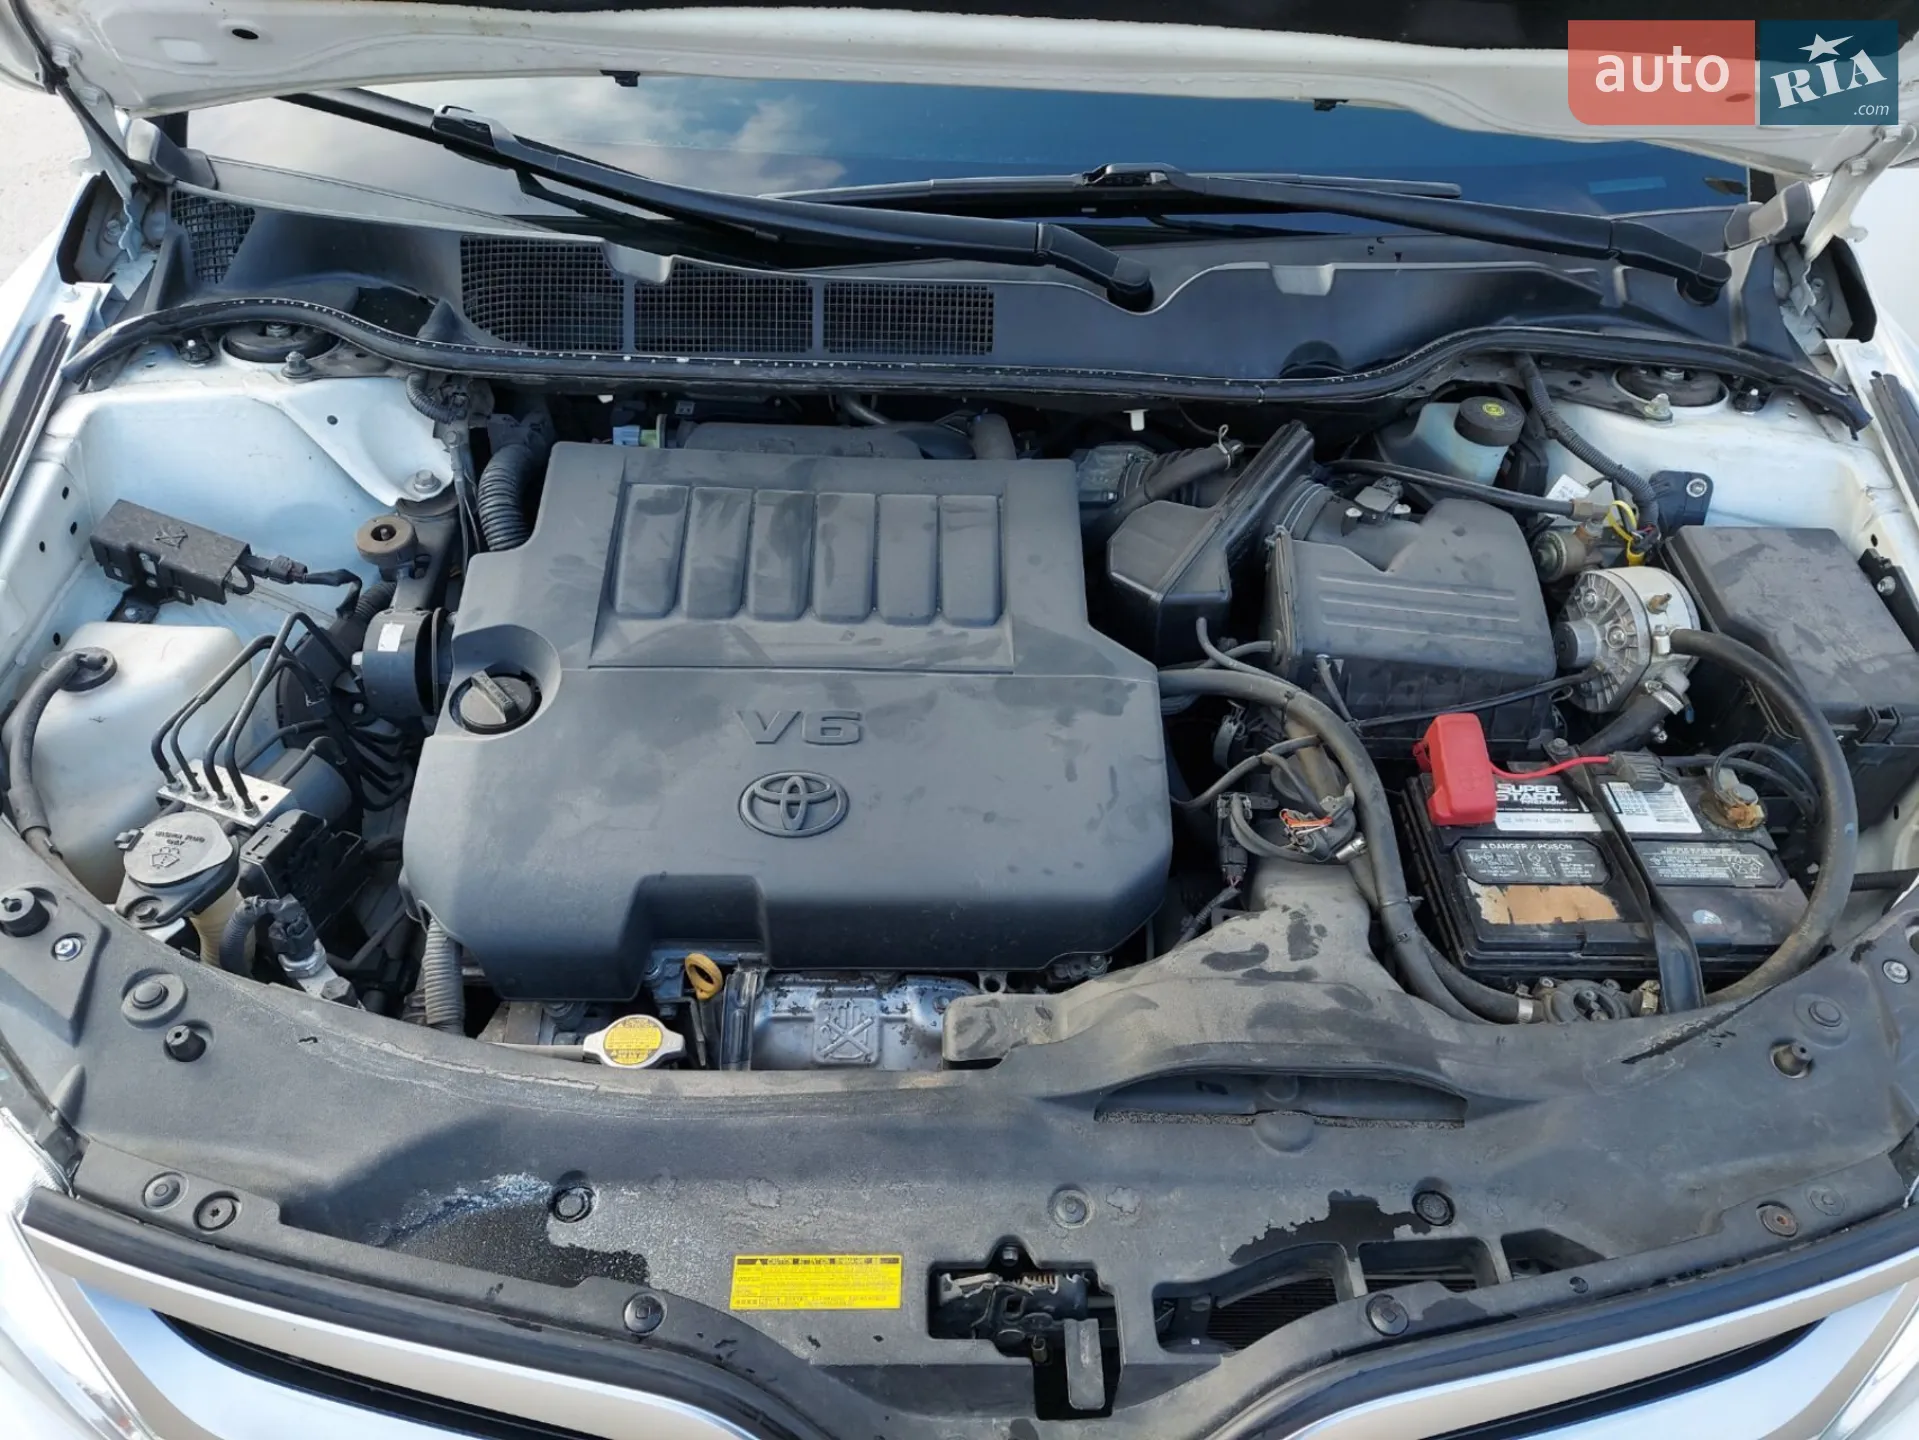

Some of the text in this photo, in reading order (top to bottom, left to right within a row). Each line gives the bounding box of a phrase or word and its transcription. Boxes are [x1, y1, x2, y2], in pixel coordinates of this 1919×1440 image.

[733, 709, 864, 746] V6
[1496, 783, 1559, 793] SUPER
[1495, 791, 1562, 802] START
